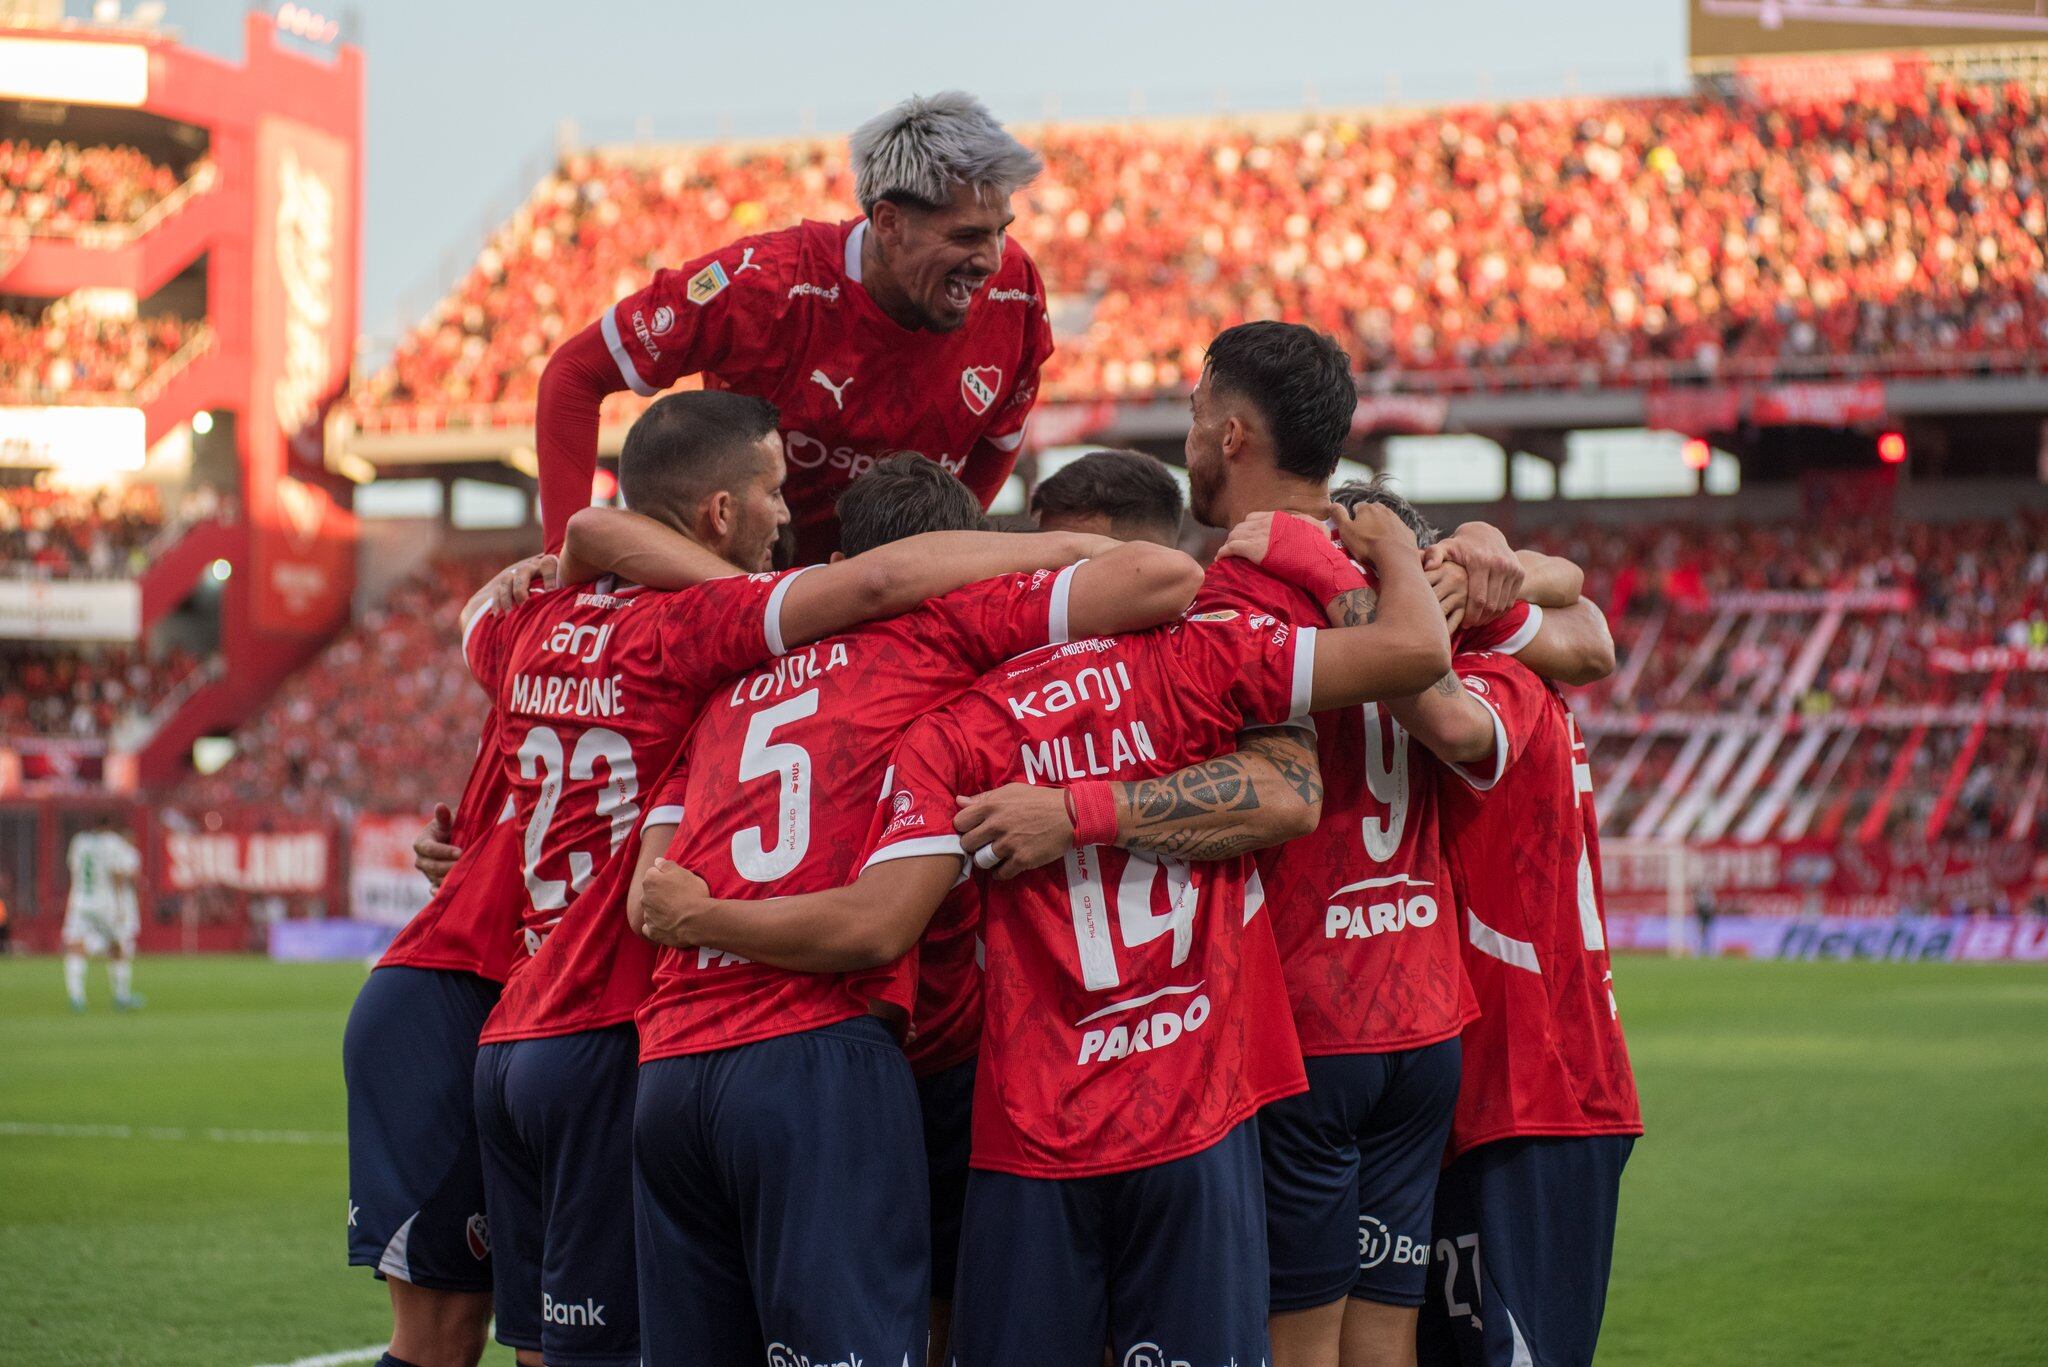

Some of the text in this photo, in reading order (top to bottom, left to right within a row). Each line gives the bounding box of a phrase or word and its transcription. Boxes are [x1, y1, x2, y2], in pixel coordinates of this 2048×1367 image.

[632, 310, 661, 362] SCIENZA
[510, 673, 625, 717] MARCONE
[730, 643, 849, 708] LOYOLA
[1007, 661, 1131, 720] kanji
[731, 687, 820, 883] 5
[792, 762, 800, 781] RUS
[1021, 720, 1157, 785] MILLAN
[1362, 702, 1410, 862] 9
[517, 725, 641, 911] 23
[1084, 895, 1096, 938] MULTILED
[1077, 994, 1211, 1066] PARDO
[1436, 1232, 1482, 1318] 27
[542, 1292, 606, 1327] Bank
